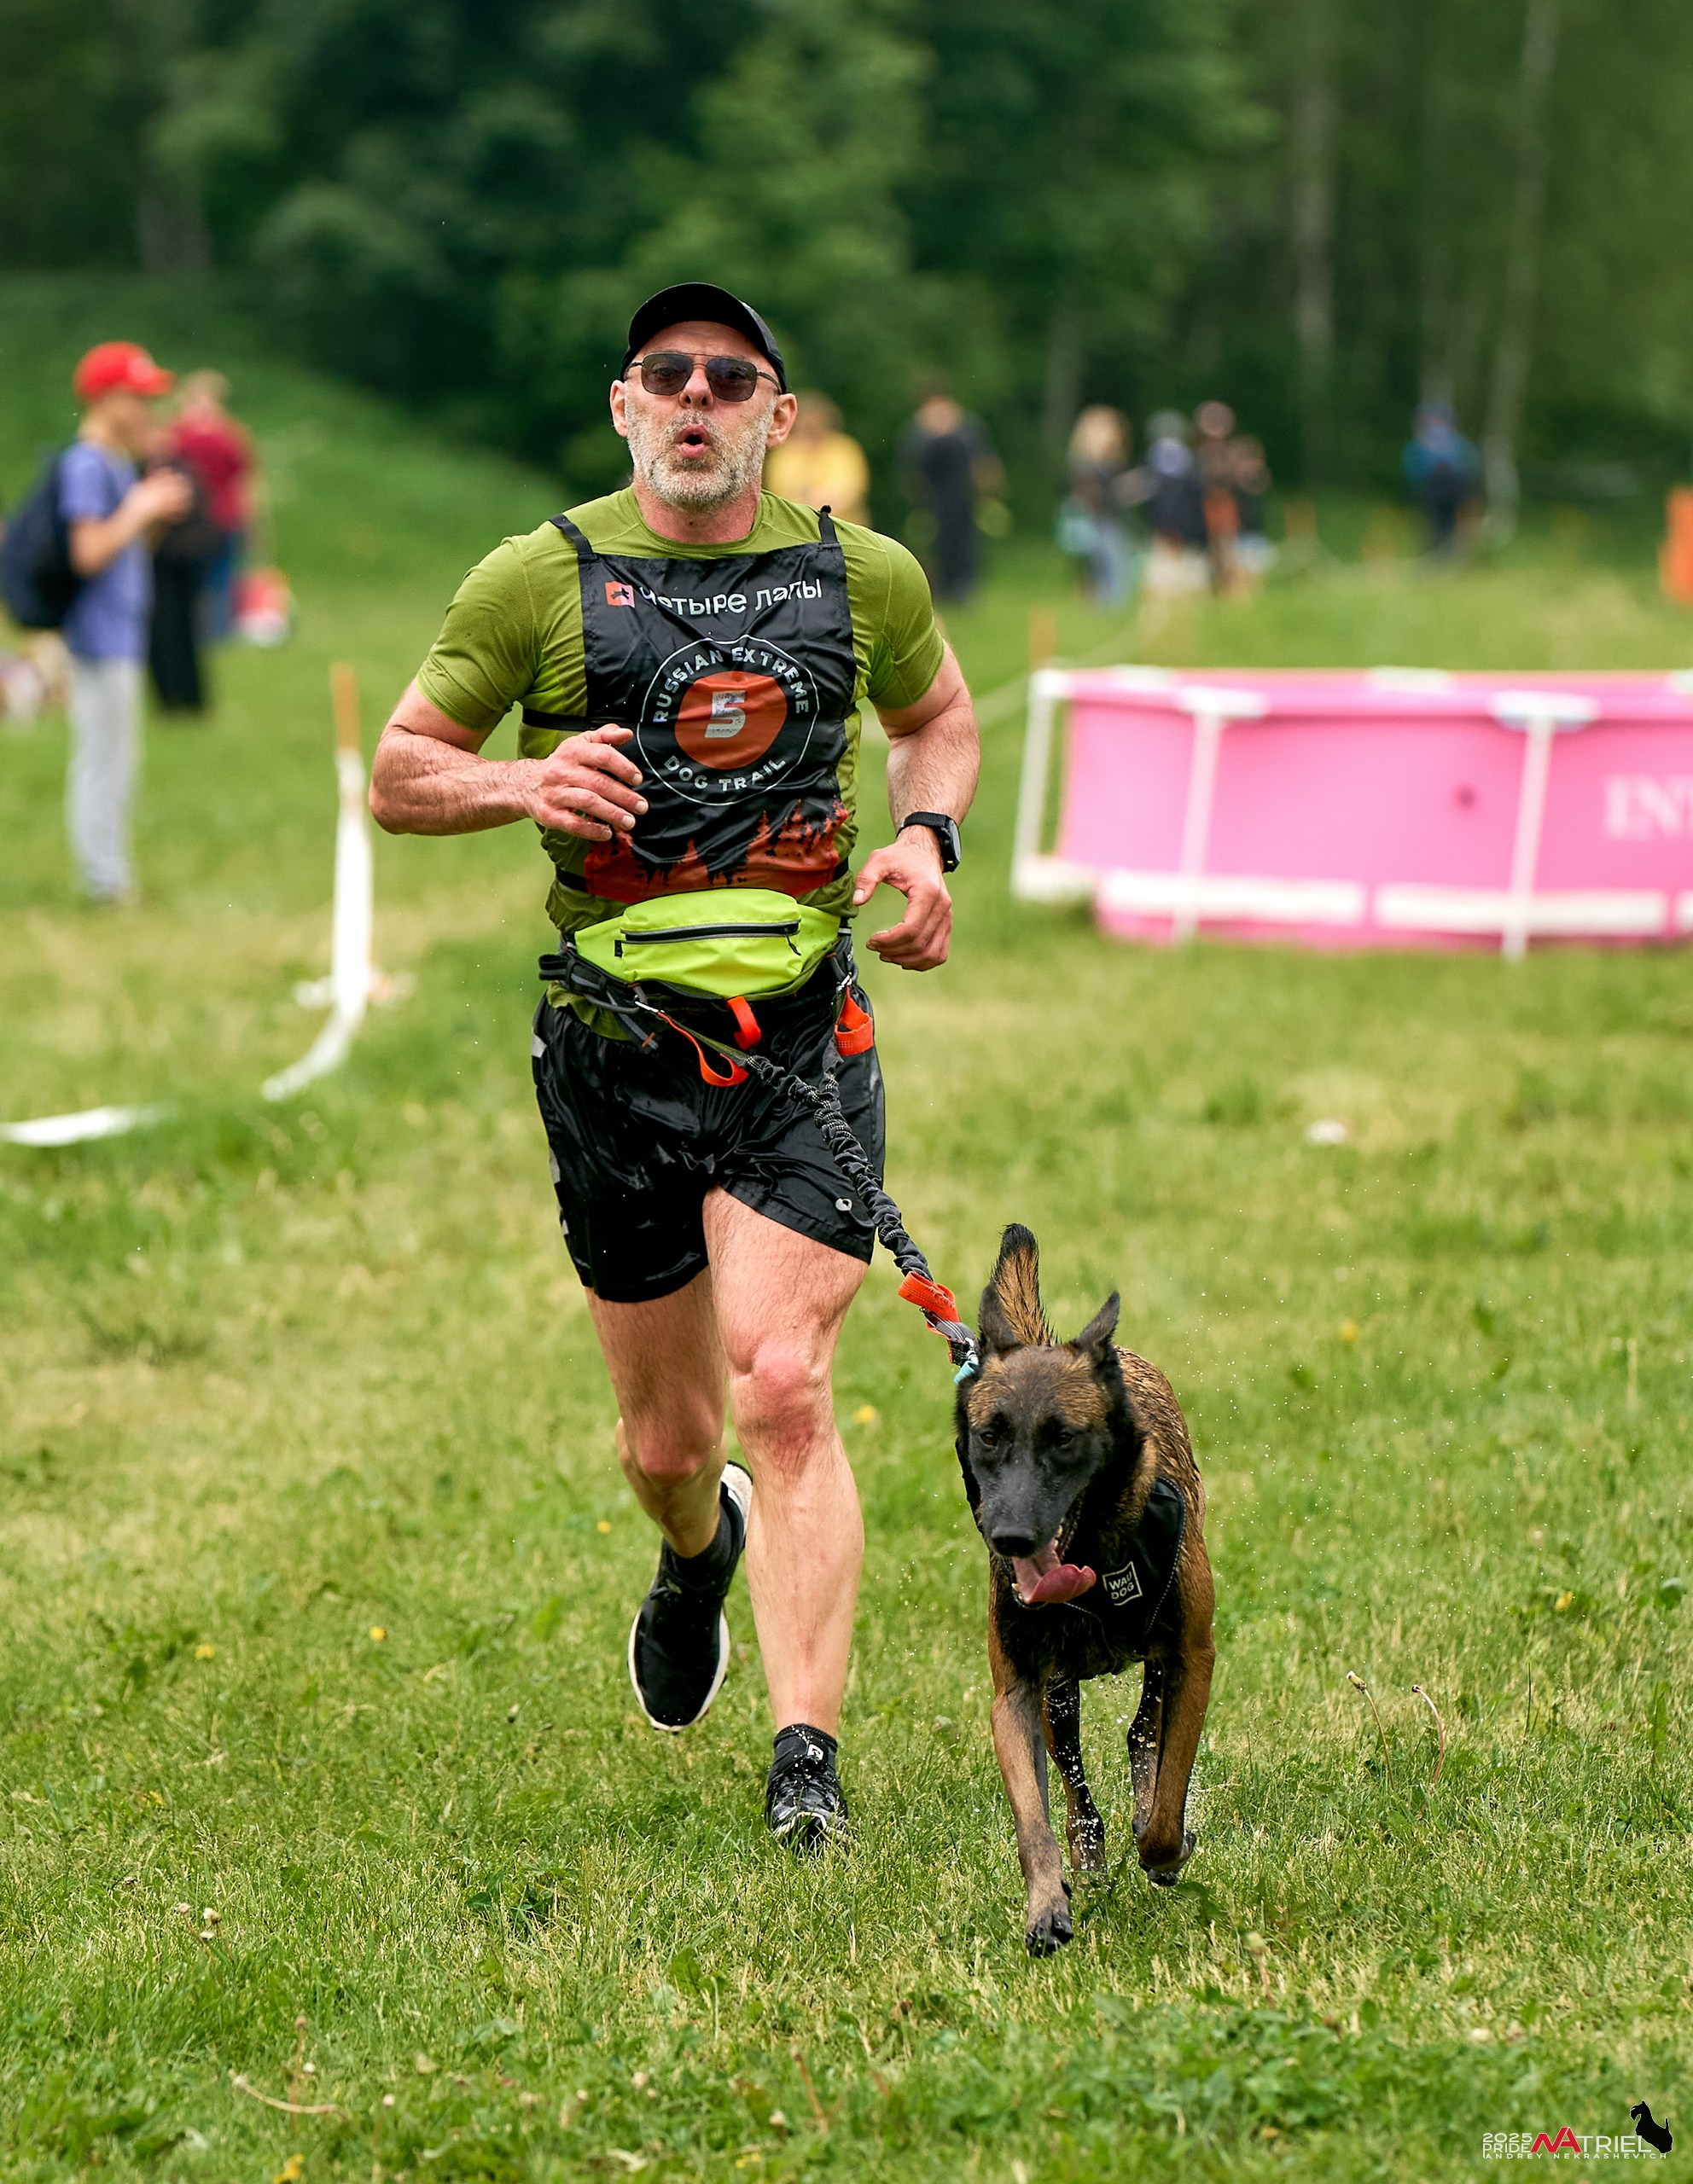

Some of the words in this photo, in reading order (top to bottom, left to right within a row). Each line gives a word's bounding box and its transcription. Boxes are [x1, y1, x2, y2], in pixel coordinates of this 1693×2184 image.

[653, 650, 724, 723] RUSSIAN
[730, 647, 810, 714] EXTREME
[704, 690, 747, 738] 5
[663, 755, 709, 790] DOG
[719, 759, 788, 792] TRAIL
[1601, 775, 1693, 841] IN
[1108, 1571, 1132, 1590] WAU
[1110, 1582, 1135, 1600] DOG
